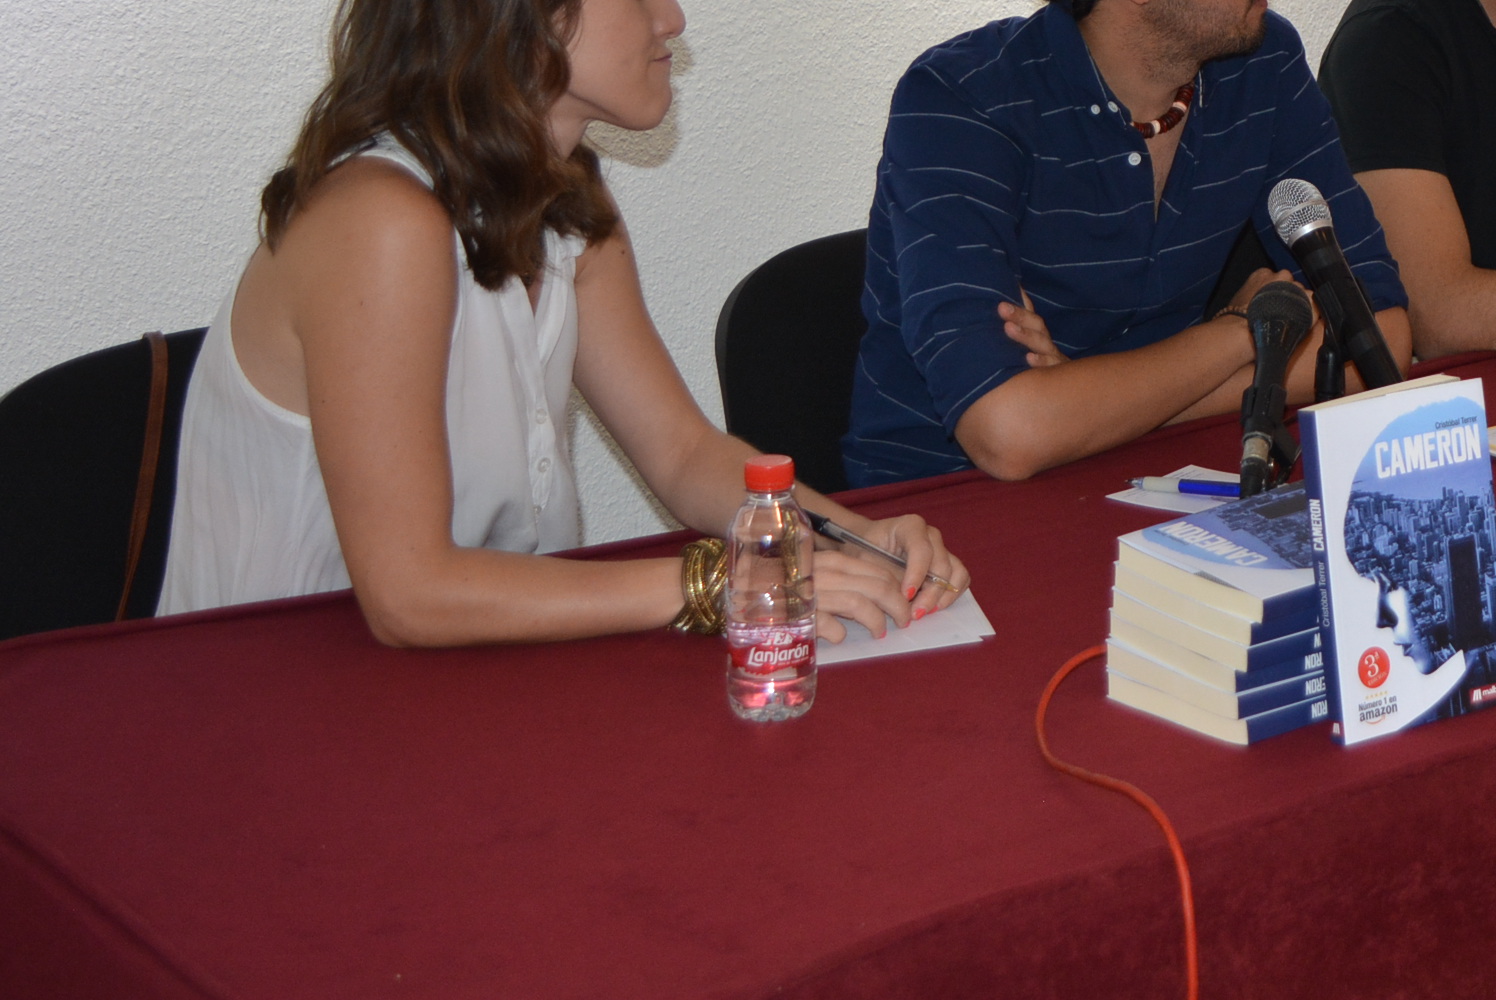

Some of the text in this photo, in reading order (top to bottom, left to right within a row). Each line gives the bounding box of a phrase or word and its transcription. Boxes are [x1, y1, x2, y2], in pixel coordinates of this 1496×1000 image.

[1435, 417, 1461, 429] Cristóbal
[1375, 423, 1482, 479] CAMERON
[1309, 498, 1325, 552] CAMERON
[1158, 521, 1269, 567] CAMERON
[1318, 561, 1326, 586] Terrer
[747, 643, 809, 667] Lanjarón
[1358, 699, 1383, 712] Número
[1389, 695, 1397, 703] en
[1359, 703, 1398, 722] amazon
